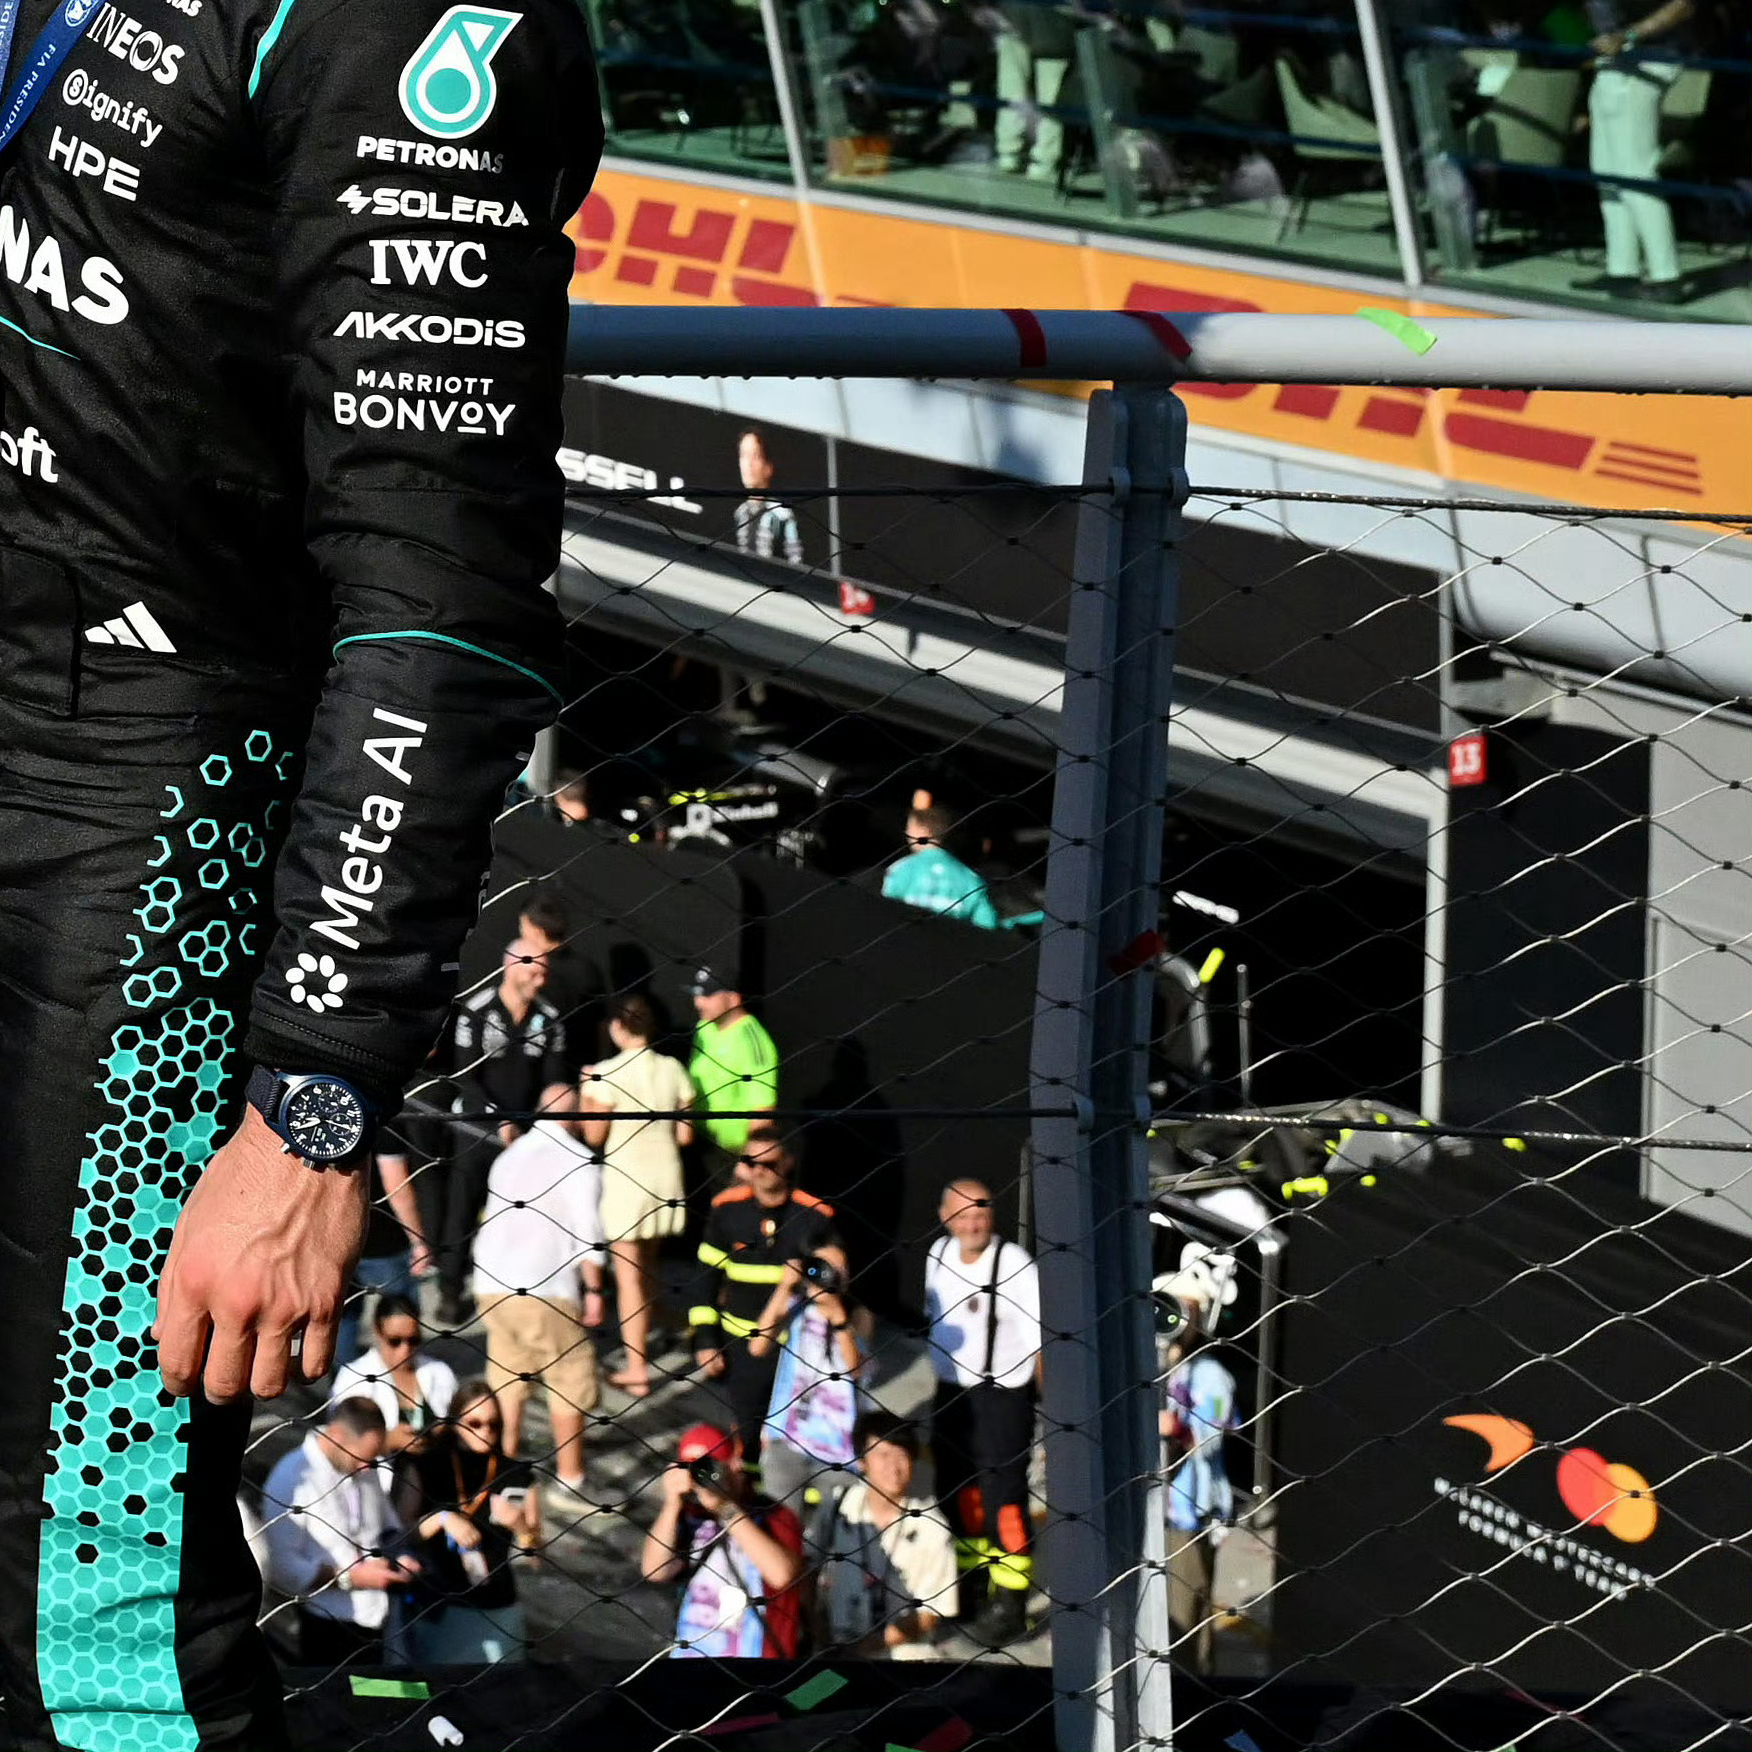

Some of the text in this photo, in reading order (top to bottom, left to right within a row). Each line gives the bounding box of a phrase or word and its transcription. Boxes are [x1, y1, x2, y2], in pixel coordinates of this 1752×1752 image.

[37, 43, 57, 67] FIA
[85, 2, 186, 85] INEOS
[48, 125, 140, 202] HPE
[356, 135, 503, 174] PETRONAS
[371, 187, 529, 228] SOLERA
[368, 239, 489, 288] IWC
[356, 368, 494, 396] MARRIOTT
[333, 392, 516, 436] BONVOY
[1451, 742, 1482, 777] 13
[308, 706, 429, 950] Meta AI
